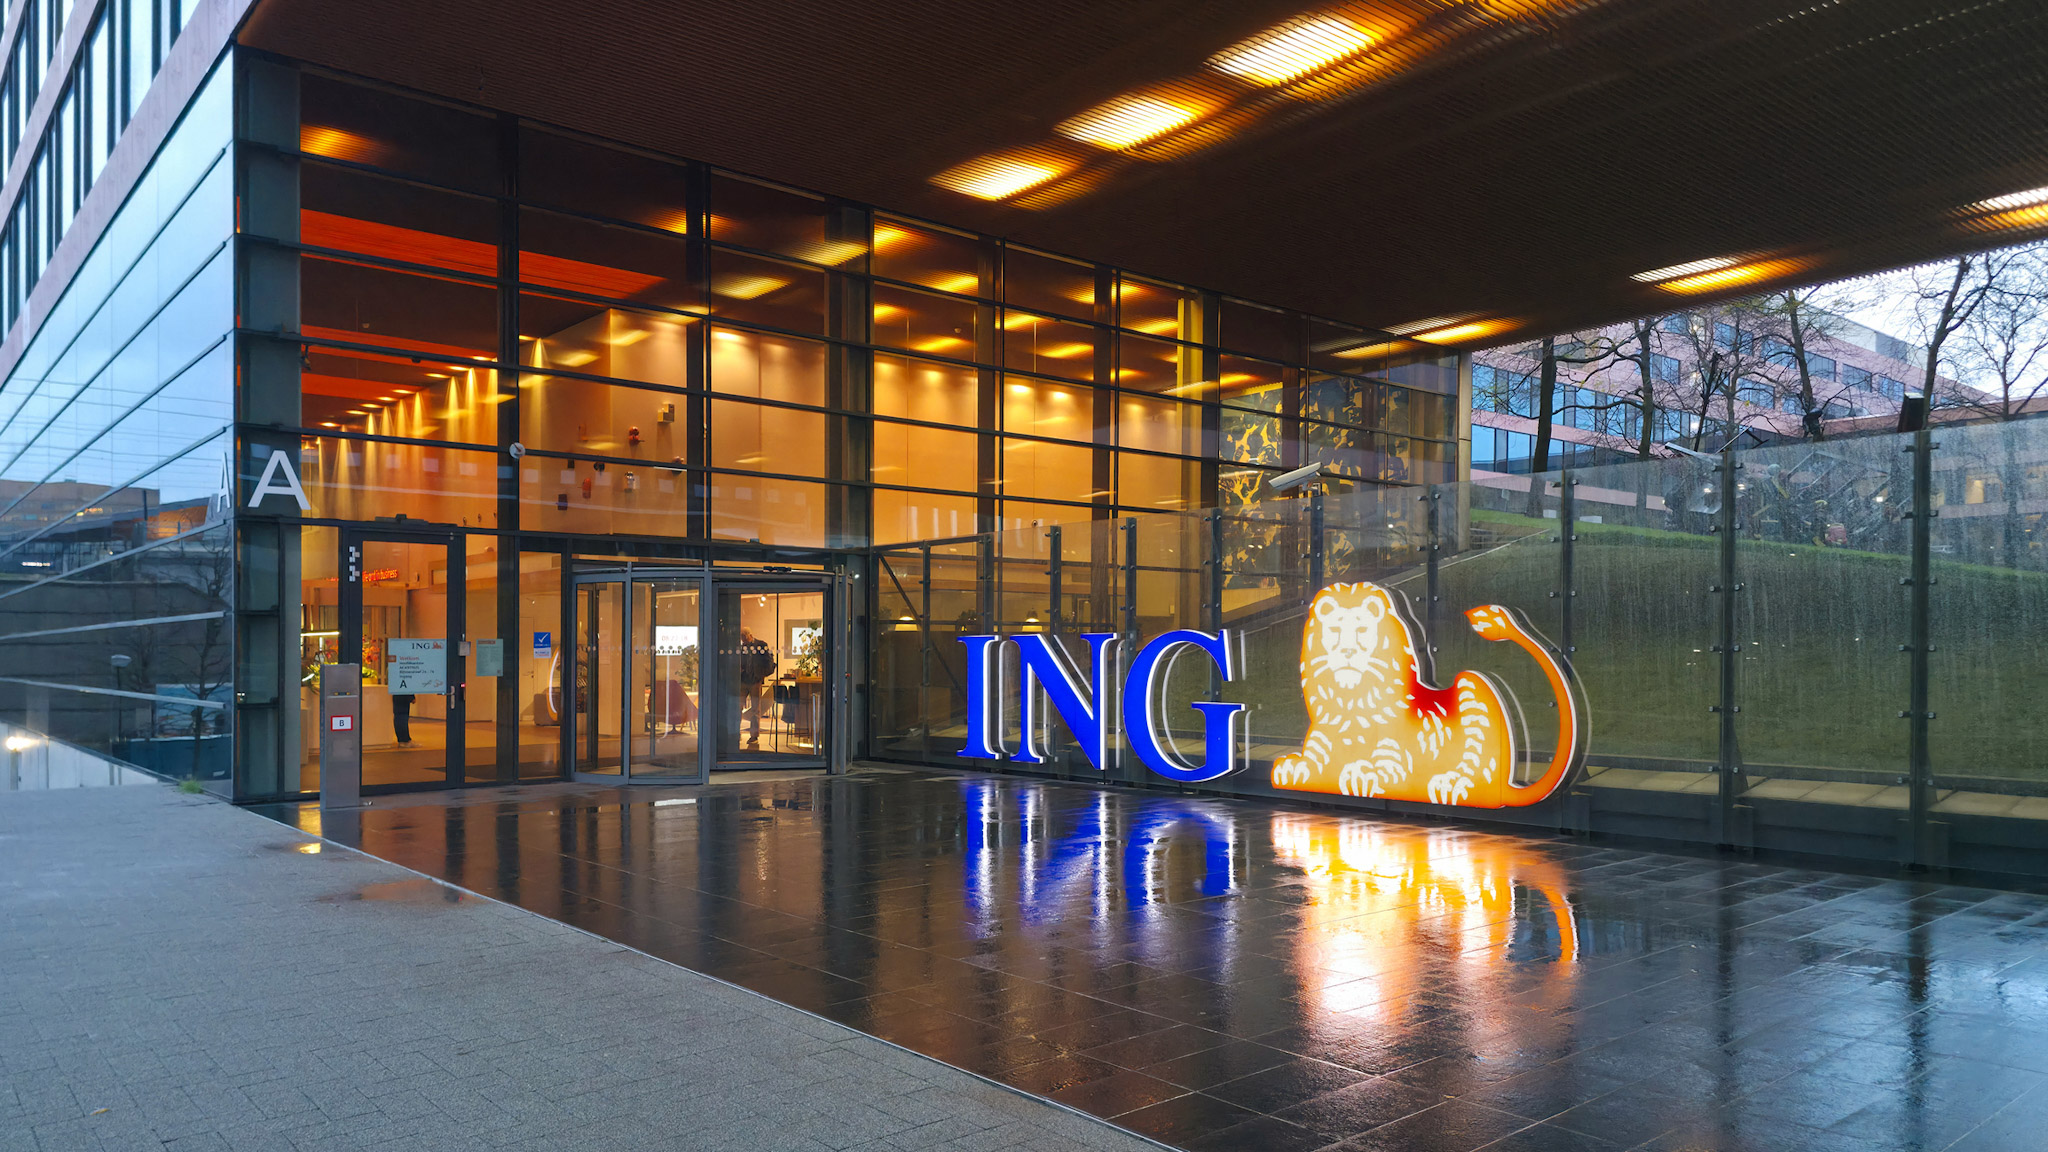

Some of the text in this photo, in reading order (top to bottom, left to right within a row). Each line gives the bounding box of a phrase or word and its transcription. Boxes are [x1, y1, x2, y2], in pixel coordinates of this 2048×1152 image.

[247, 449, 312, 511] A
[411, 642, 430, 650] ING
[399, 679, 407, 689] A
[956, 628, 1246, 783] ING
[339, 719, 345, 727] B
